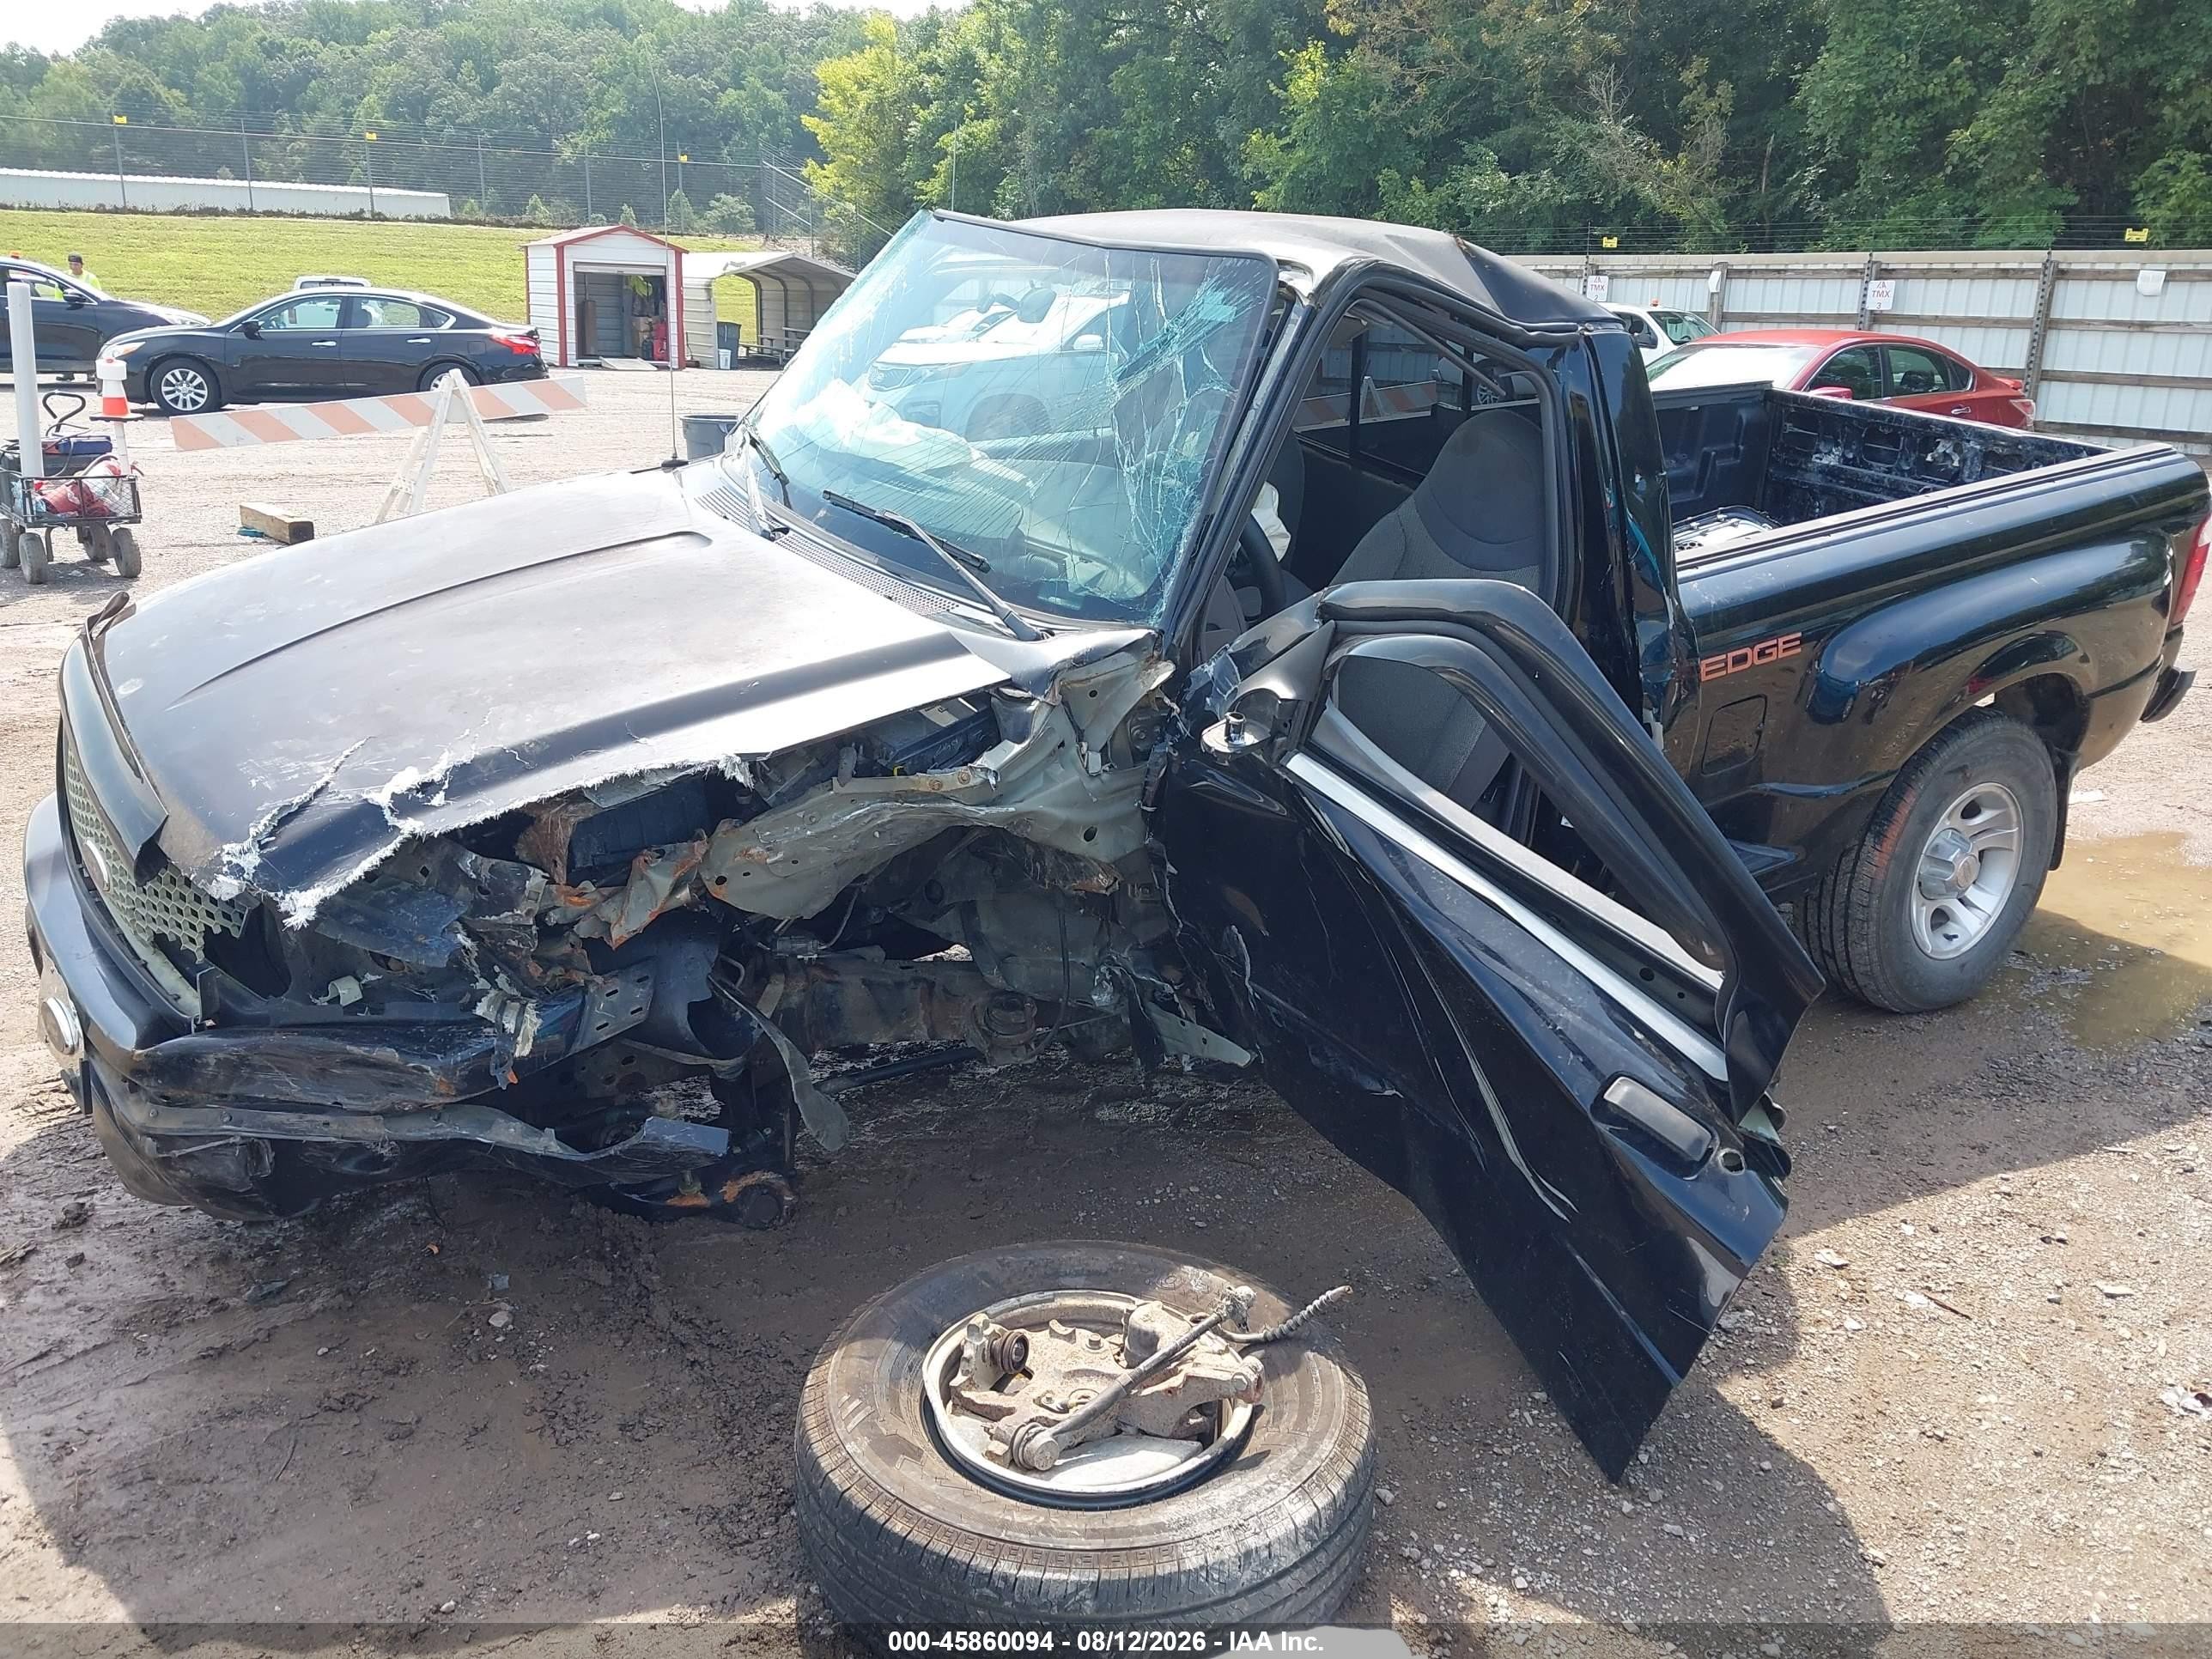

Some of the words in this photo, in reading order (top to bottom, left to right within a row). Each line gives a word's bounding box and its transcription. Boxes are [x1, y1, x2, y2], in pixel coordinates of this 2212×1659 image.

[1872, 289, 1890, 298] TMX
[1875, 301, 1882, 310] 3
[1700, 631, 1802, 682] EDGE
